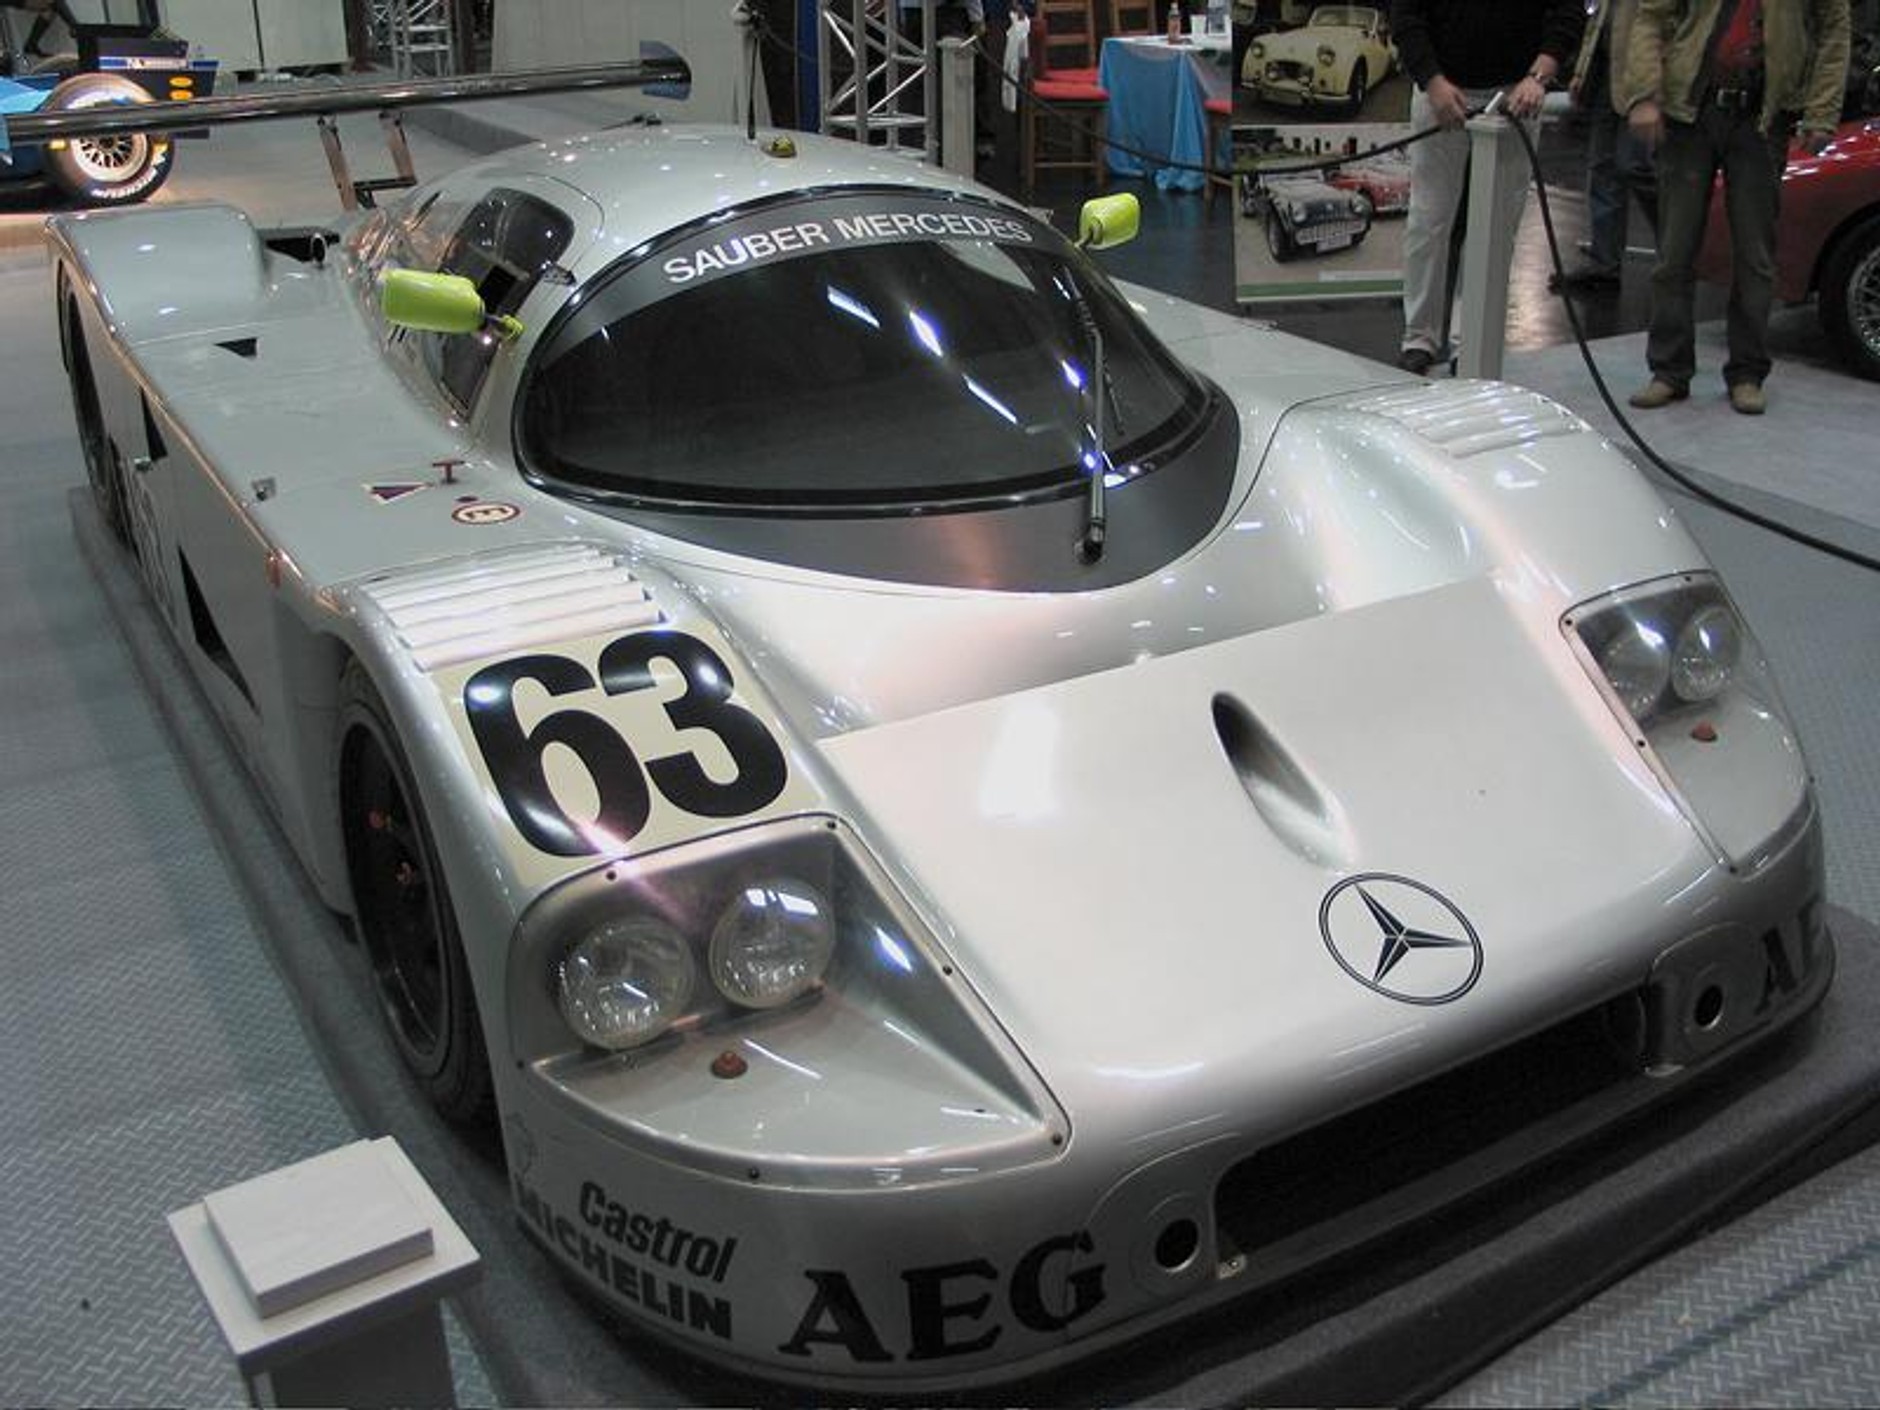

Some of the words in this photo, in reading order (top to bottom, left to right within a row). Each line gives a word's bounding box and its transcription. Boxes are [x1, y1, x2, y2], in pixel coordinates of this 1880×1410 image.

[663, 223, 831, 283] SAUBER
[832, 213, 1033, 243] MERCEDES
[463, 629, 788, 857] 63
[513, 1176, 732, 1340] MICHELIN
[579, 1181, 738, 1283] Castrol
[777, 1229, 1107, 1363] AEG
